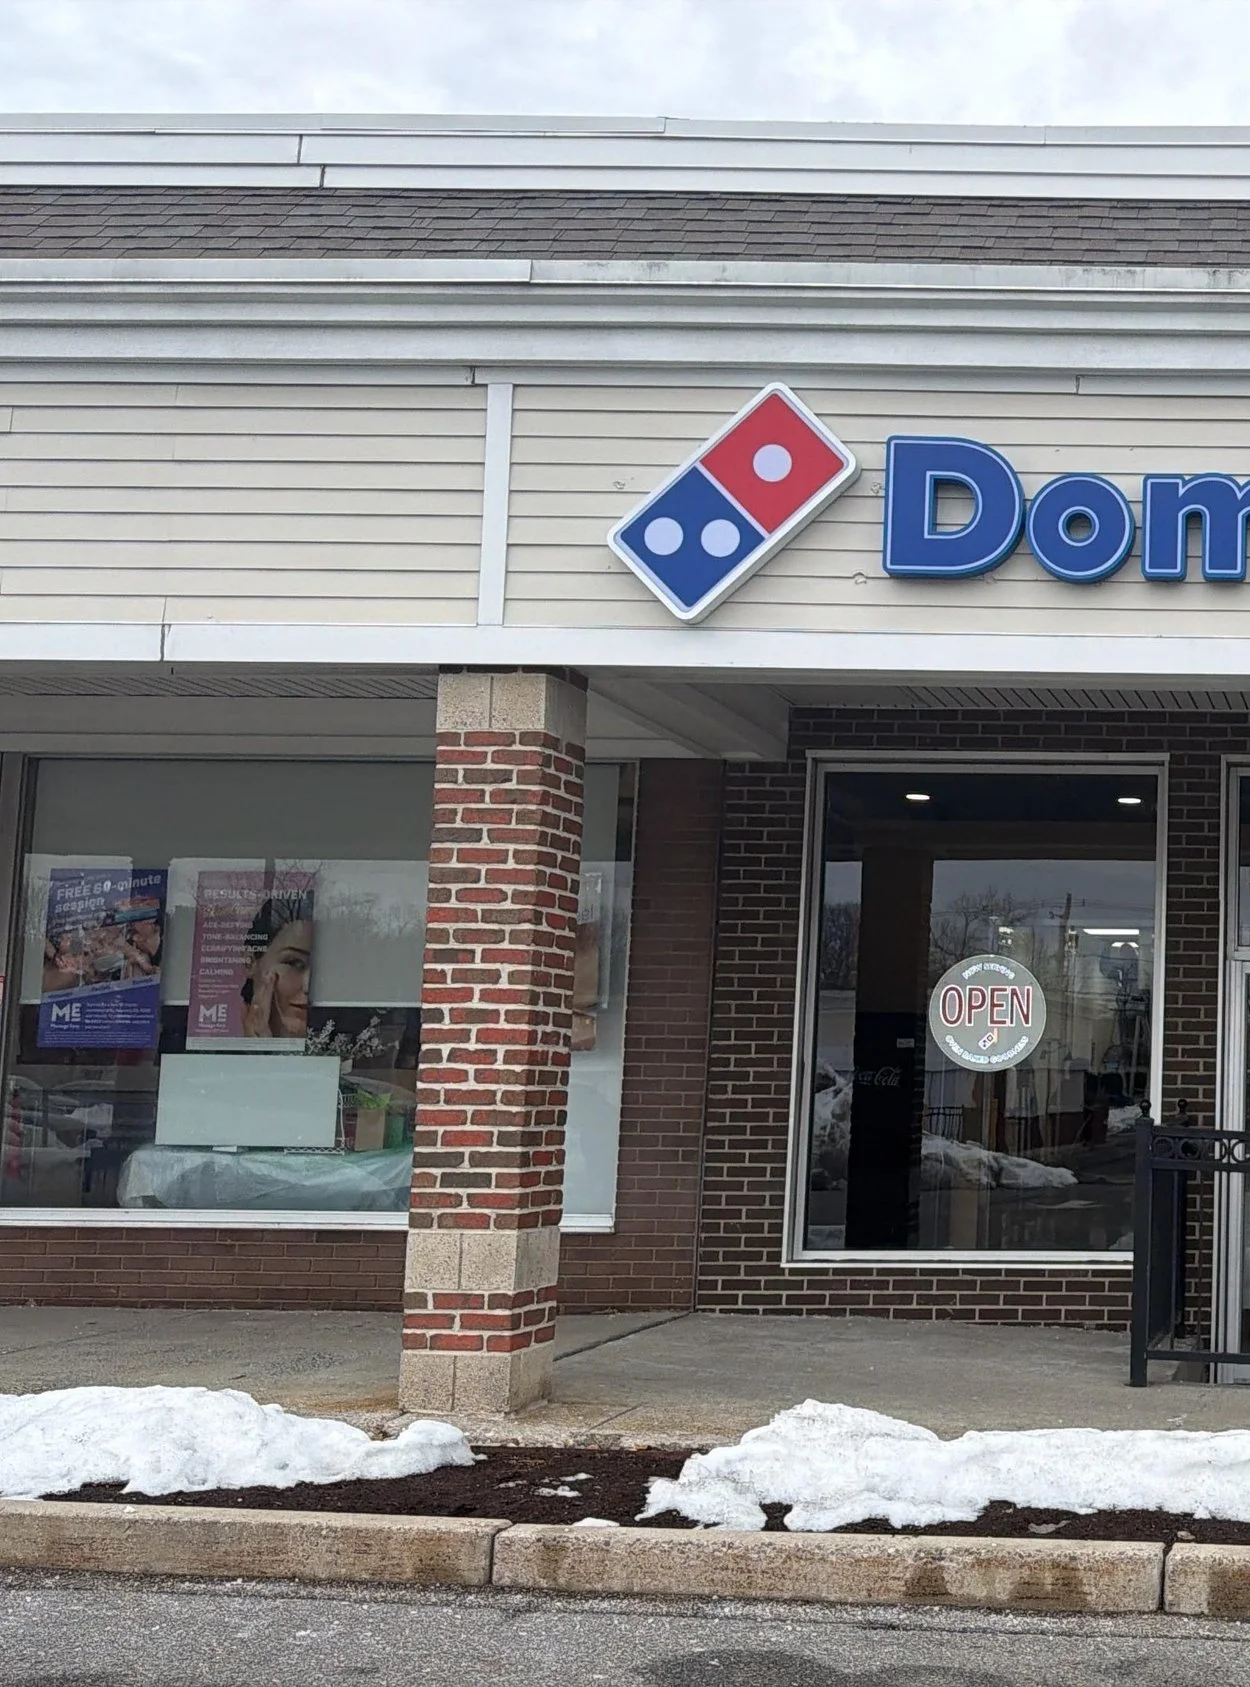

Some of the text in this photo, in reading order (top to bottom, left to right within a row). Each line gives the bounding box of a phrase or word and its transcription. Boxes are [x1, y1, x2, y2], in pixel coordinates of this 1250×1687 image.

[56, 884, 92, 901] FREE
[51, 1002, 82, 1022] ME
[199, 1004, 228, 1022] ME
[940, 985, 1032, 1027] OPEN
